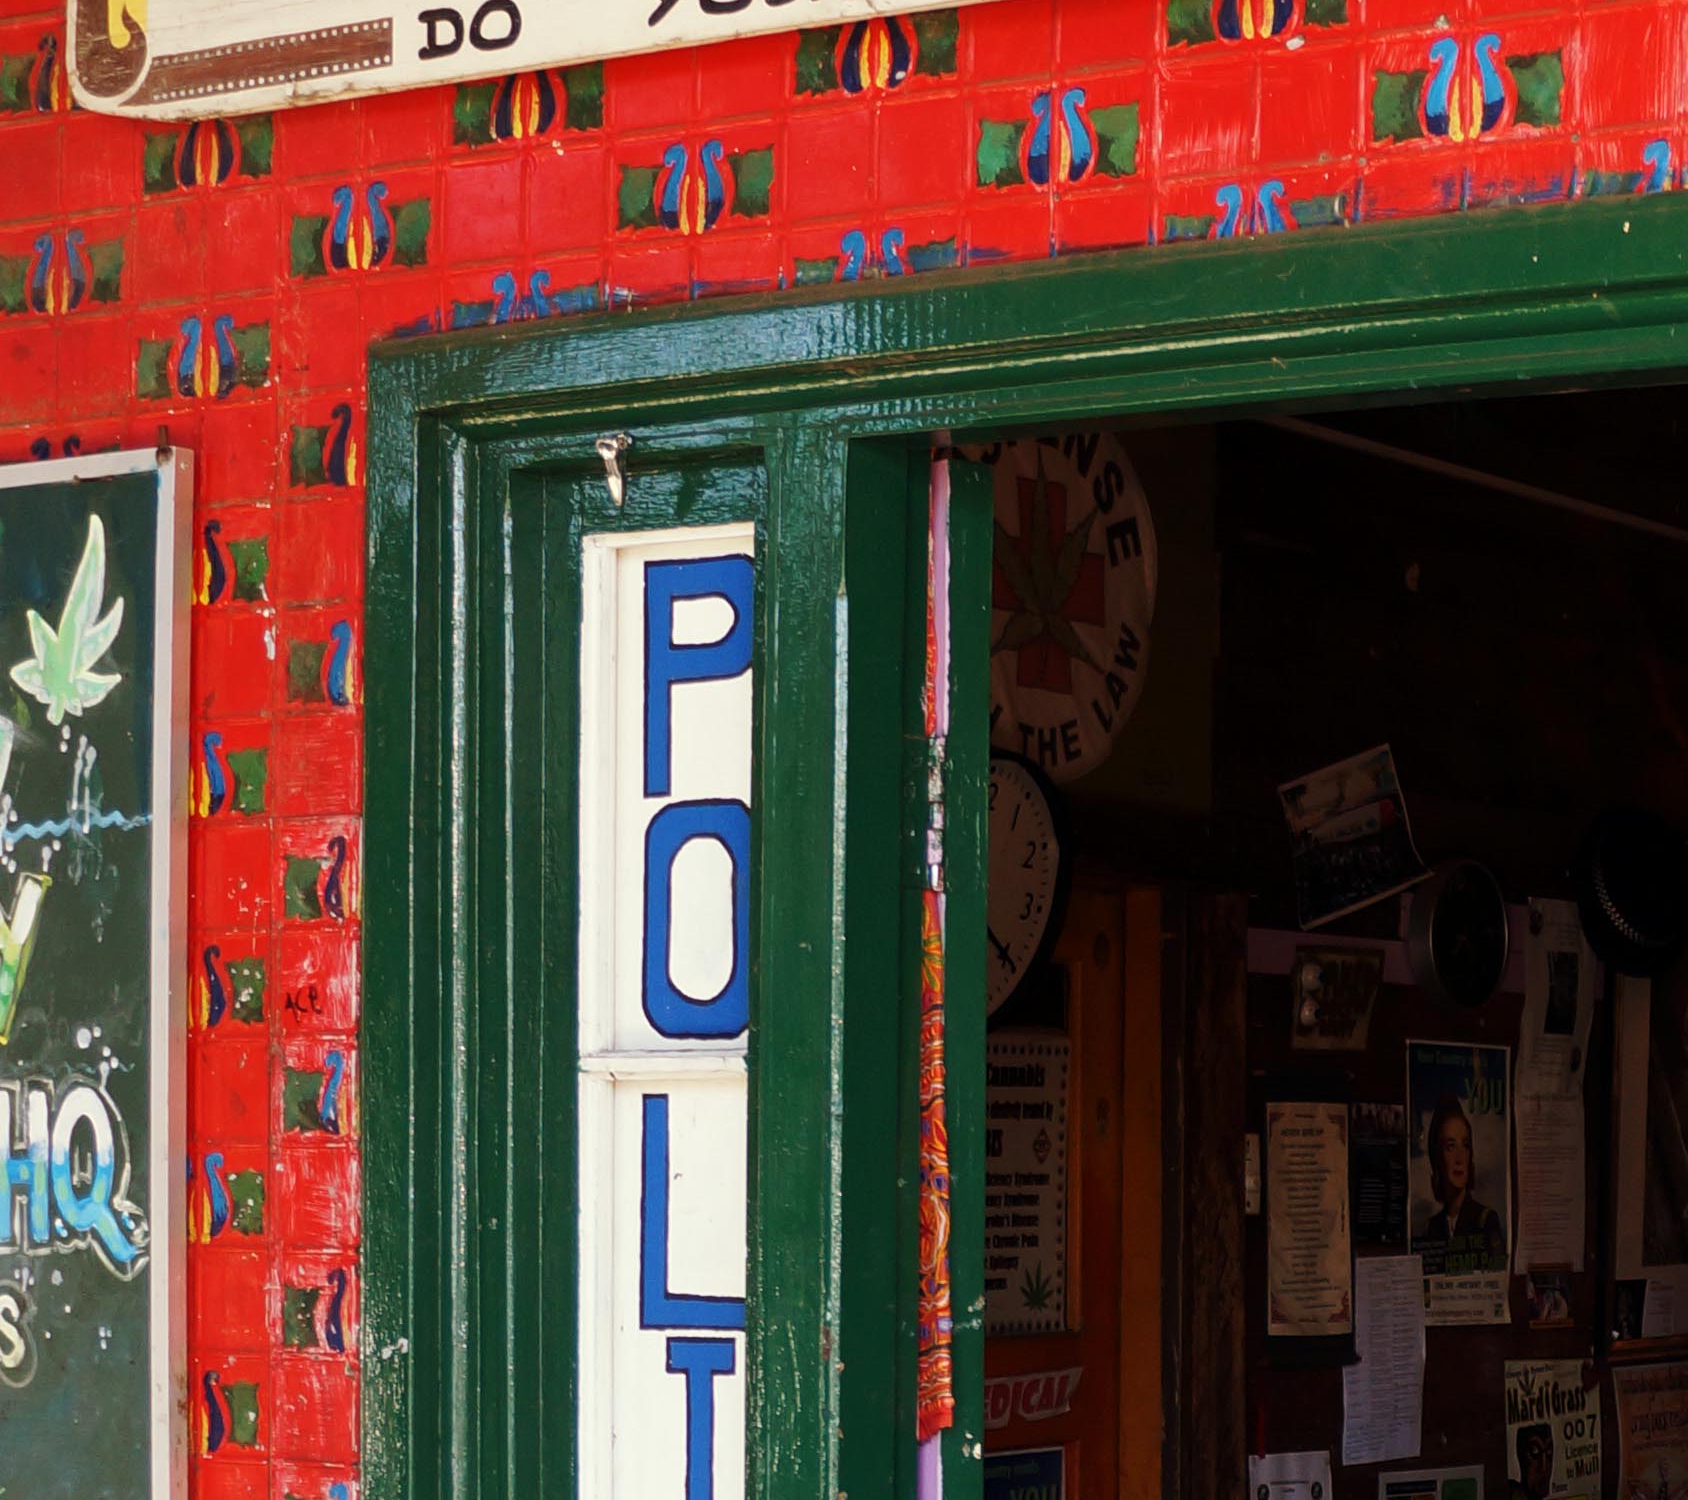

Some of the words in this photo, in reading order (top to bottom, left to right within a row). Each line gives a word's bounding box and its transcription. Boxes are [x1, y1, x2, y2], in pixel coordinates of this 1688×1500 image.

[1017, 720, 1082, 767] THE
[1092, 623, 1142, 733] LAW
[1021, 841, 1038, 869] 2
[1018, 892, 1034, 921] 3
[1464, 1077, 1506, 1115] YOU
[986, 1374, 1070, 1421] DICAL
[1563, 1413, 1597, 1441] 007
